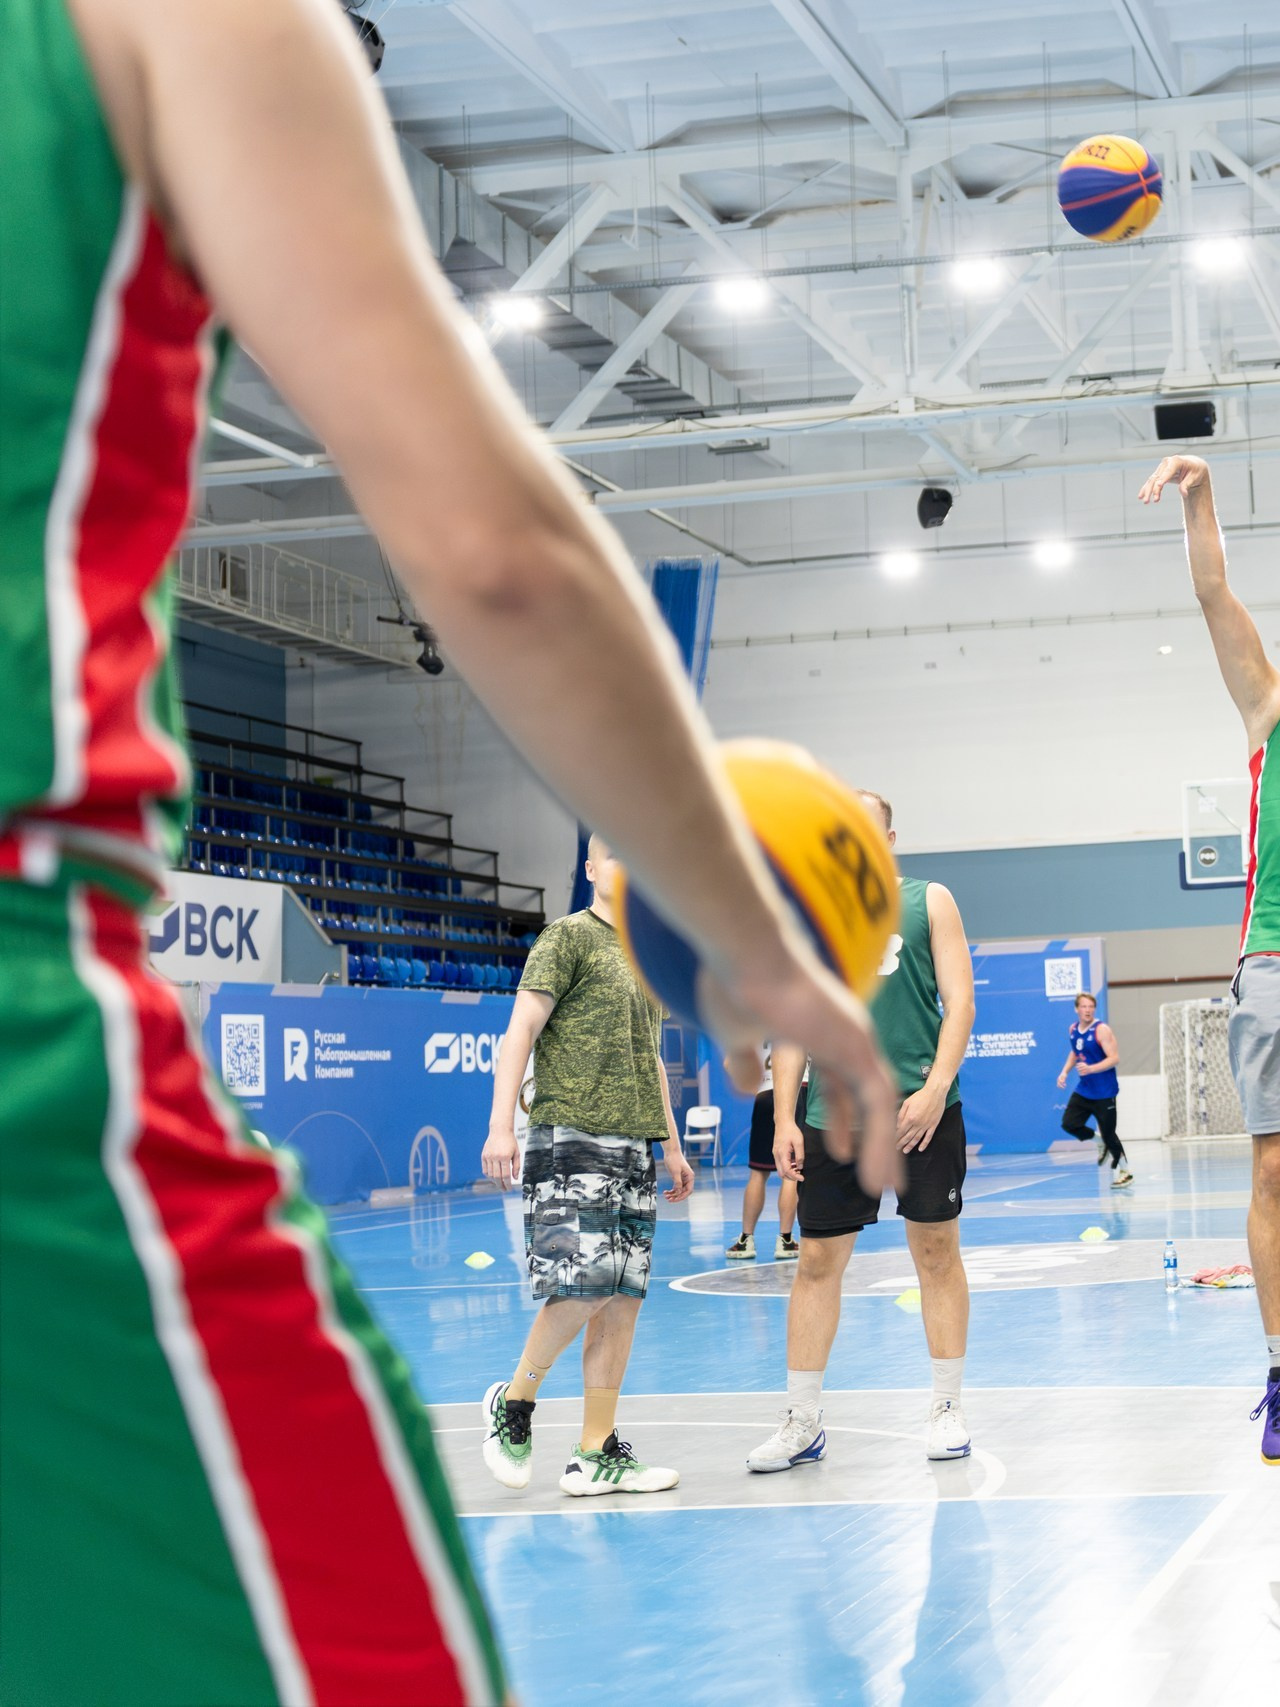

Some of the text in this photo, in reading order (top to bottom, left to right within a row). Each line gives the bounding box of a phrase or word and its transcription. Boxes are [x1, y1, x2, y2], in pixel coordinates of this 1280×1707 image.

[184, 902, 260, 964] ВСК
[314, 1029, 346, 1047] Русская
[977, 1032, 1034, 1042] ЧЕМПИОНАТ
[982, 1040, 1037, 1050] СУПЕРЛИГА
[1076, 1038, 1084, 1051] 8
[314, 1046, 392, 1064] Рыбопромышленная
[978, 1048, 1029, 1057] 2025/2026
[315, 1064, 354, 1079] Компания
